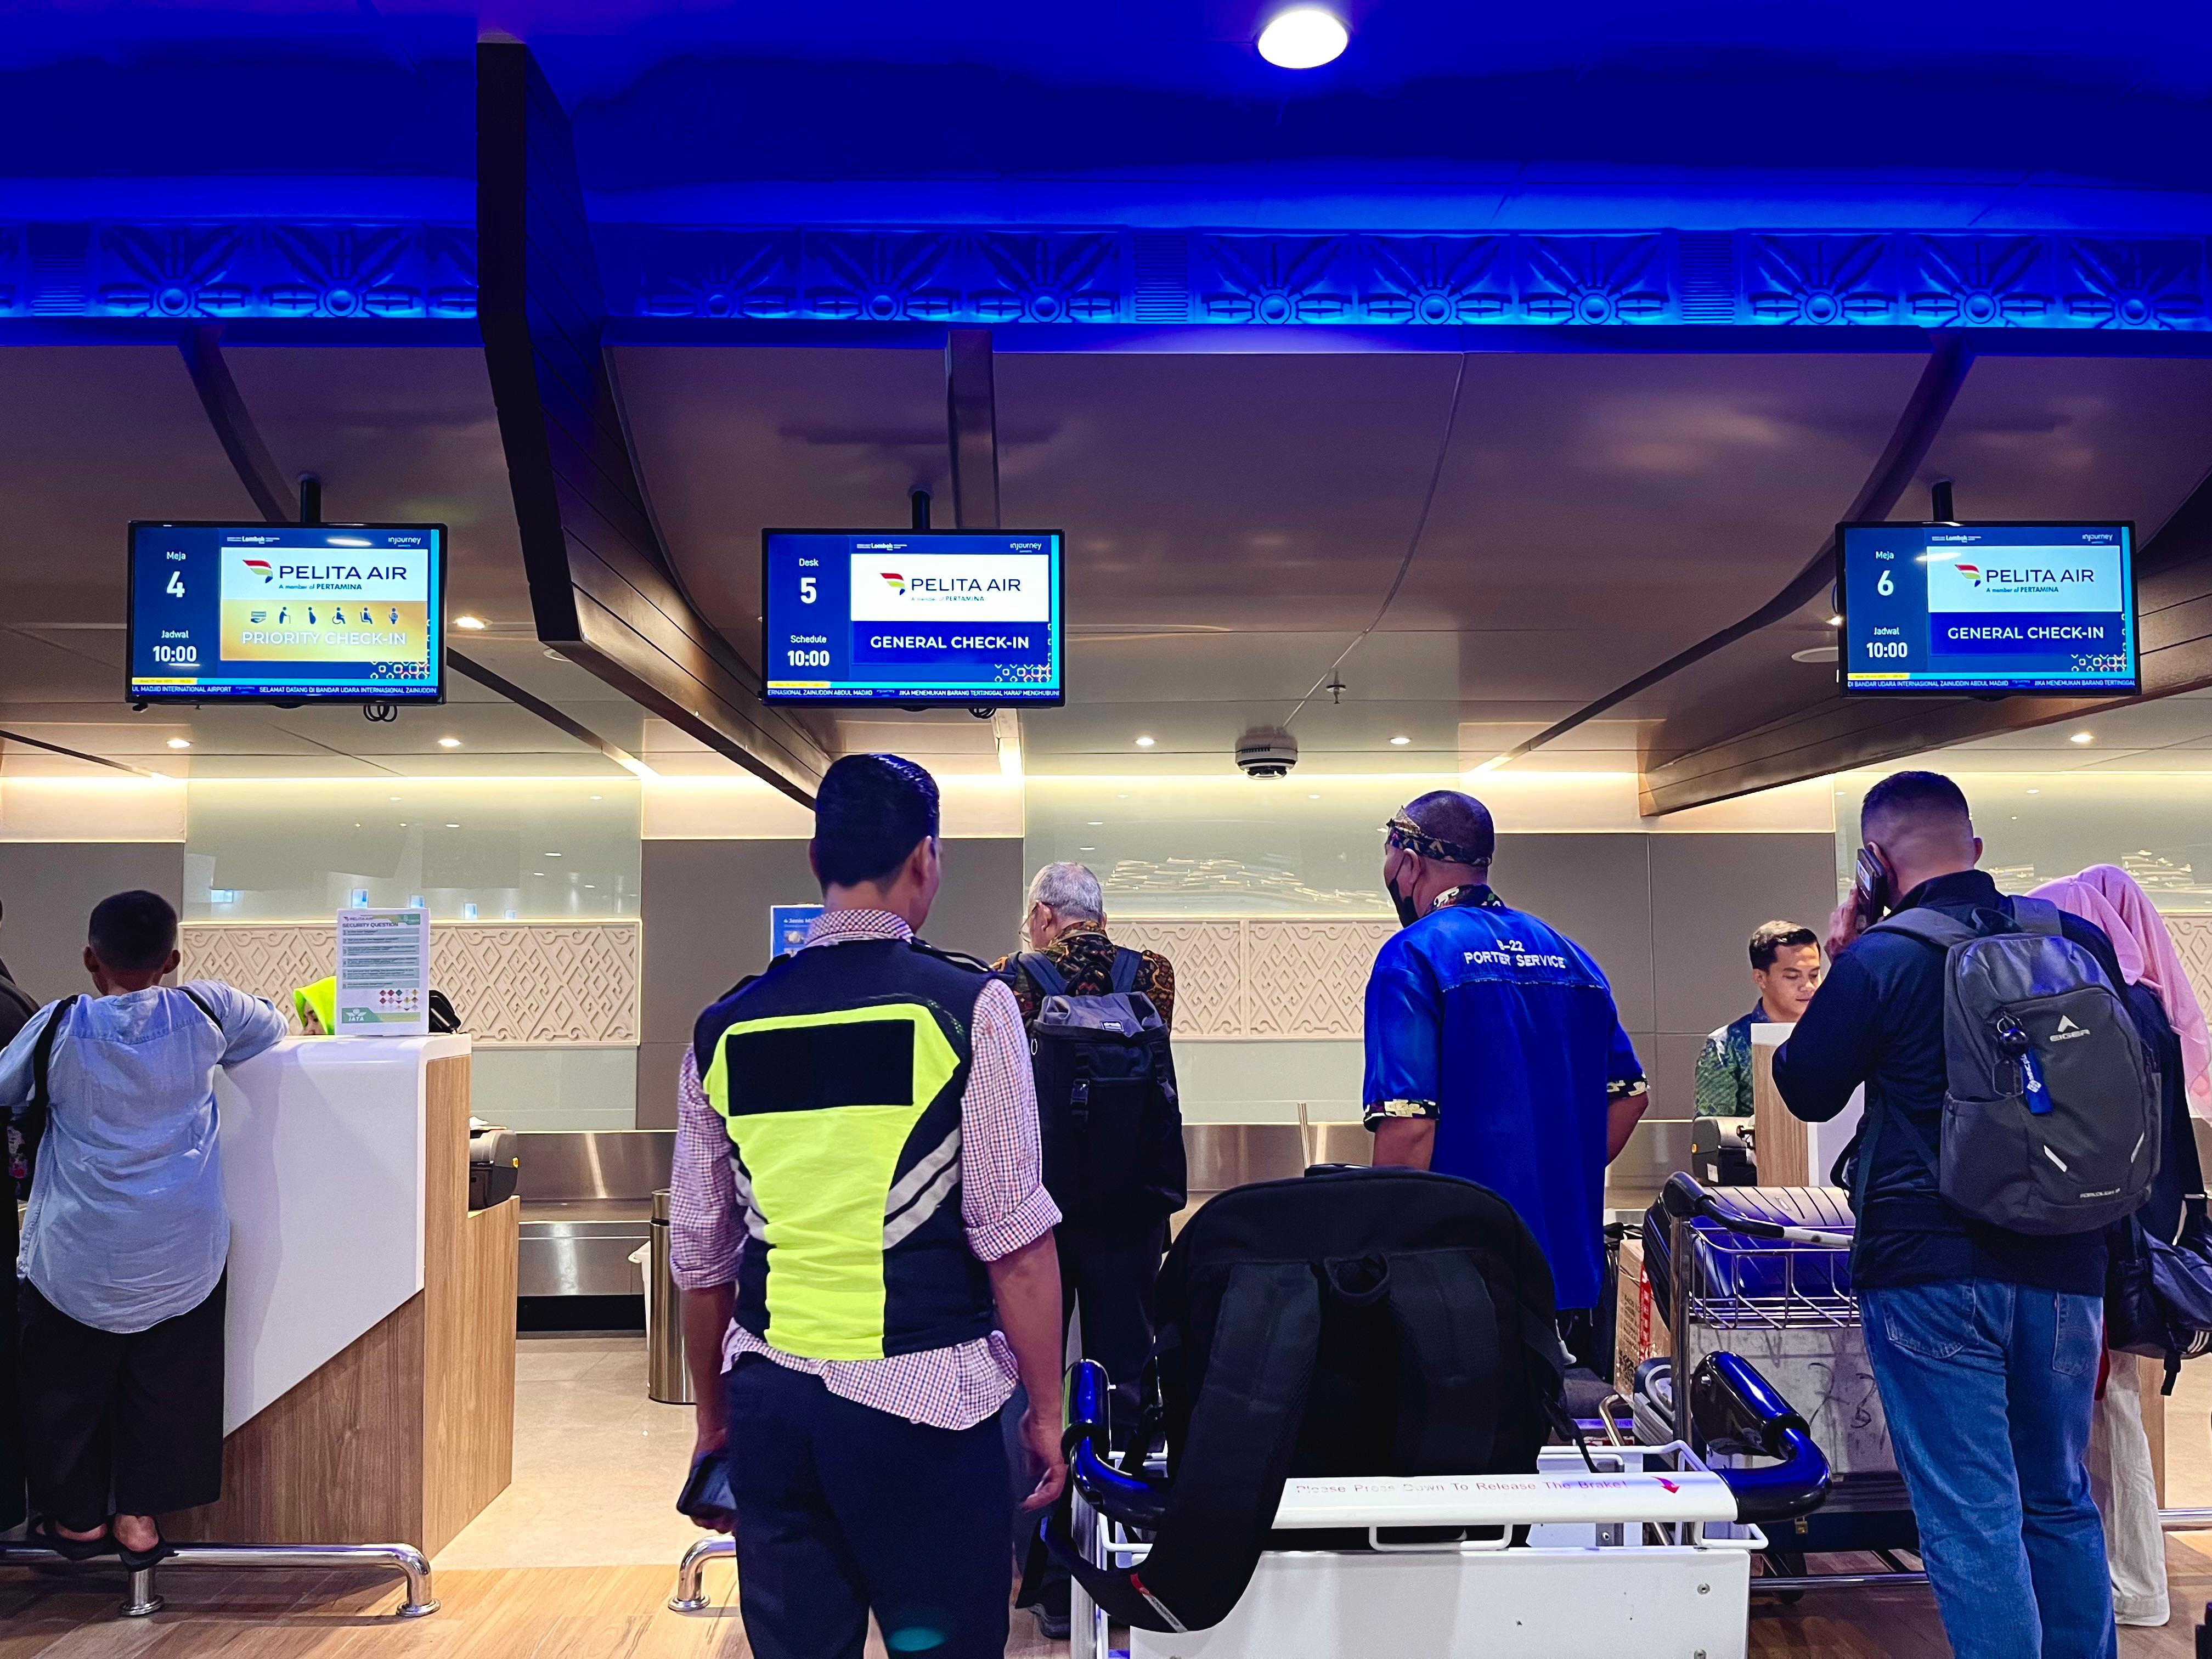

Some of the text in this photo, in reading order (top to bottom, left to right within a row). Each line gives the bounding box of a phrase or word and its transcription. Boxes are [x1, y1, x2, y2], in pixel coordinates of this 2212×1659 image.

[166, 551, 187, 561] Meja
[799, 558, 819, 567] Desk
[1875, 551, 1894, 561] Meja
[279, 566, 407, 580] PELITA AIR
[1986, 569, 2095, 583] PELITA AIR
[166, 571, 185, 598] 4
[911, 578, 1021, 591] PELITA AIR
[1877, 569, 1894, 596] 6
[800, 577, 817, 604] 5
[161, 630, 189, 639] Jadwal
[1874, 627, 1900, 635] Jadwal
[1948, 627, 2104, 639] GENERAL CHECK-IN
[241, 631, 406, 645] PRIORITY CHECK-IN
[790, 635, 827, 644] Schedule
[870, 636, 1029, 649] GENERAL CHECK-IN
[153, 645, 197, 662] 10:00
[1866, 642, 1908, 658] 10:00
[787, 650, 830, 667] 10:00
[1463, 951, 1566, 969] PORTER SERVICE
[2050, 1029, 2091, 1042] EIGER
[1451, 1482, 1469, 1491] To
[1476, 1482, 1536, 1491] Release
[1542, 1481, 1571, 1489] The
[1578, 1480, 1628, 1489] Brake!
